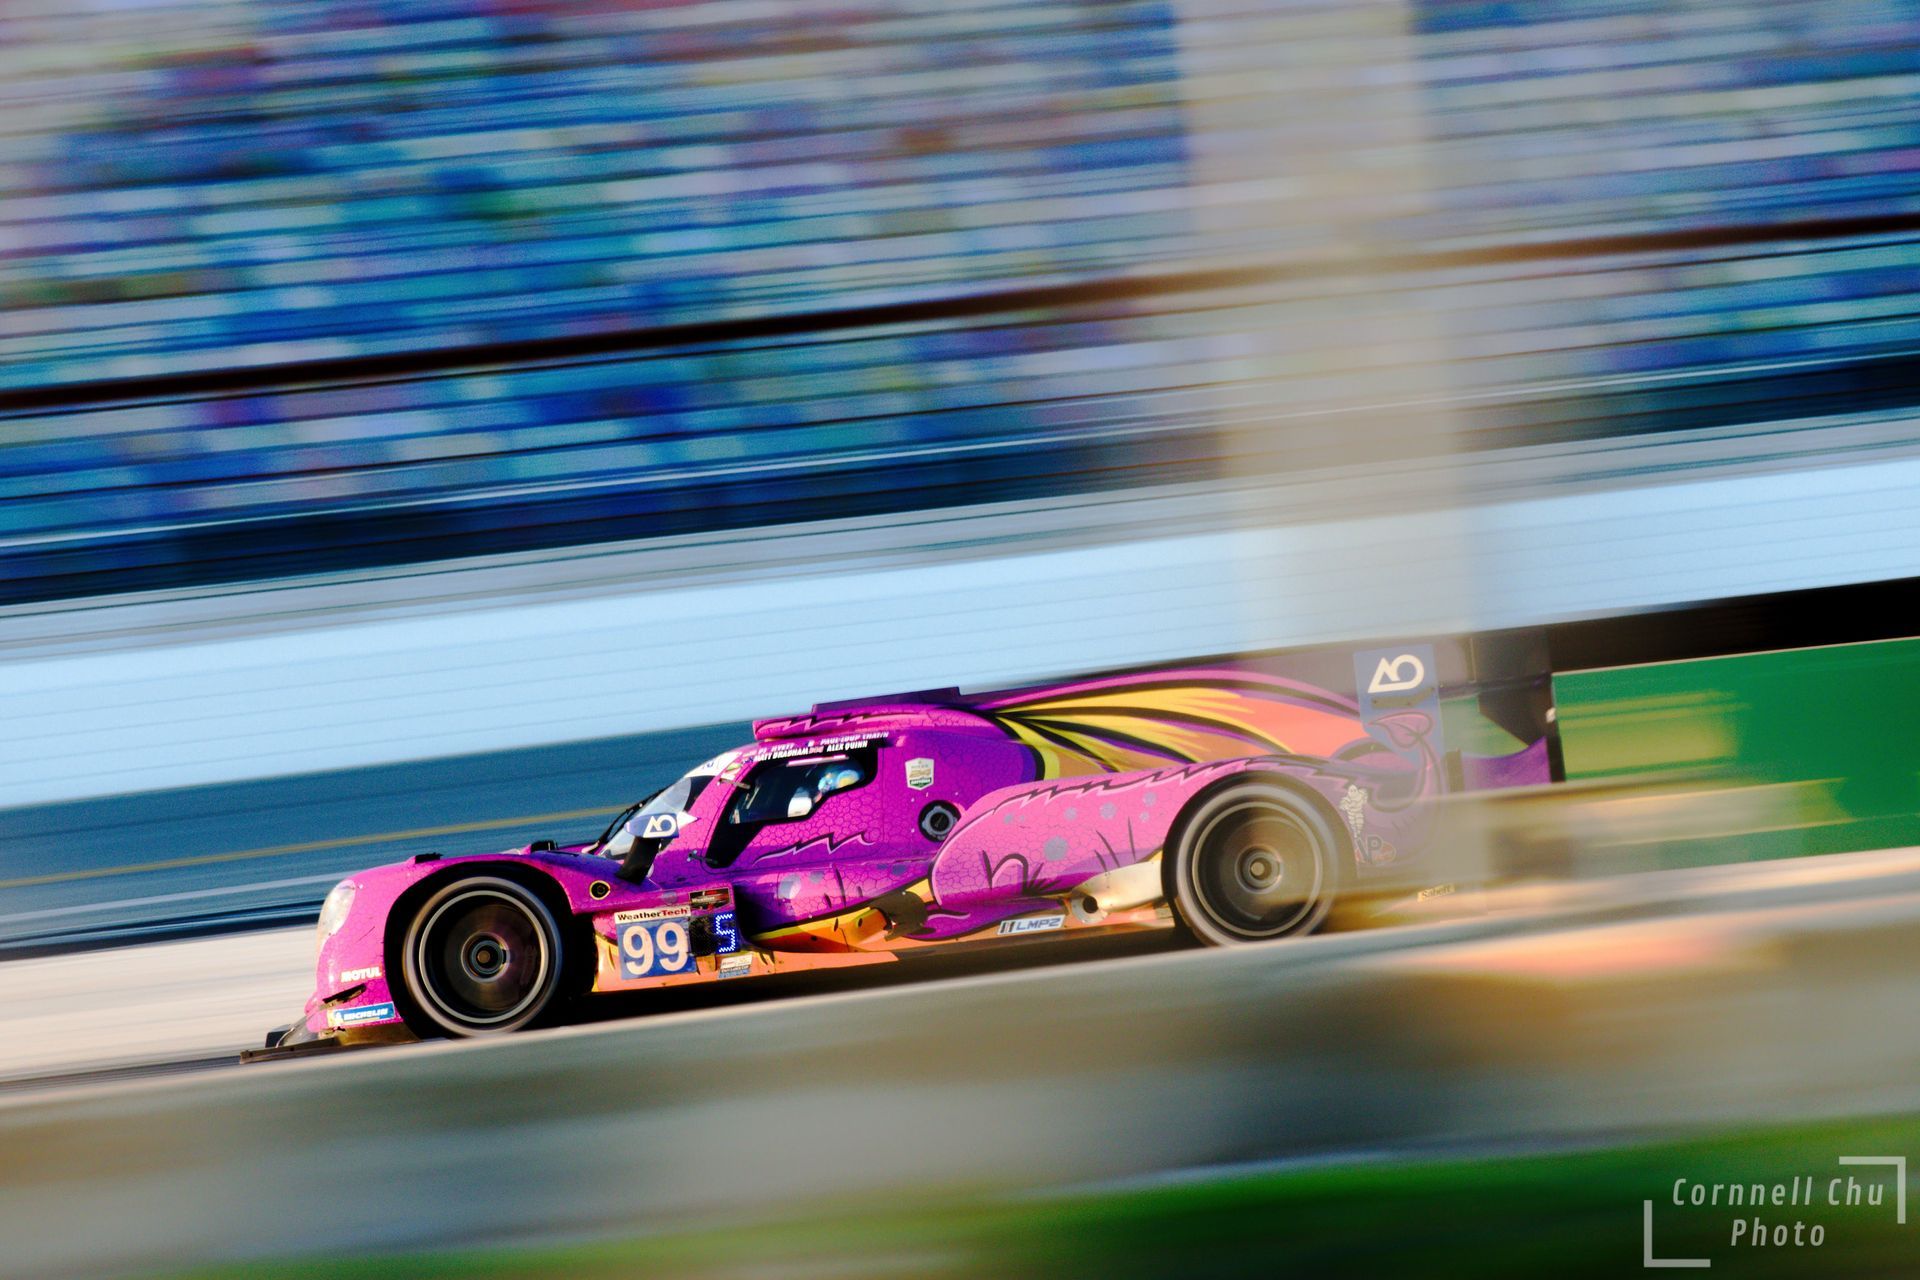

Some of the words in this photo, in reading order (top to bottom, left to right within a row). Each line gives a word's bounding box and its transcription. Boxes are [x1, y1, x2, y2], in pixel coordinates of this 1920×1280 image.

[826, 742, 845, 753] ALEX
[844, 740, 868, 751] QUINN
[618, 907, 689, 921] WeatherTech
[1016, 918, 1061, 930] LMP2
[622, 922, 689, 975] 99
[341, 966, 382, 982] MOTUL
[343, 1008, 388, 1021] MICHELIN
